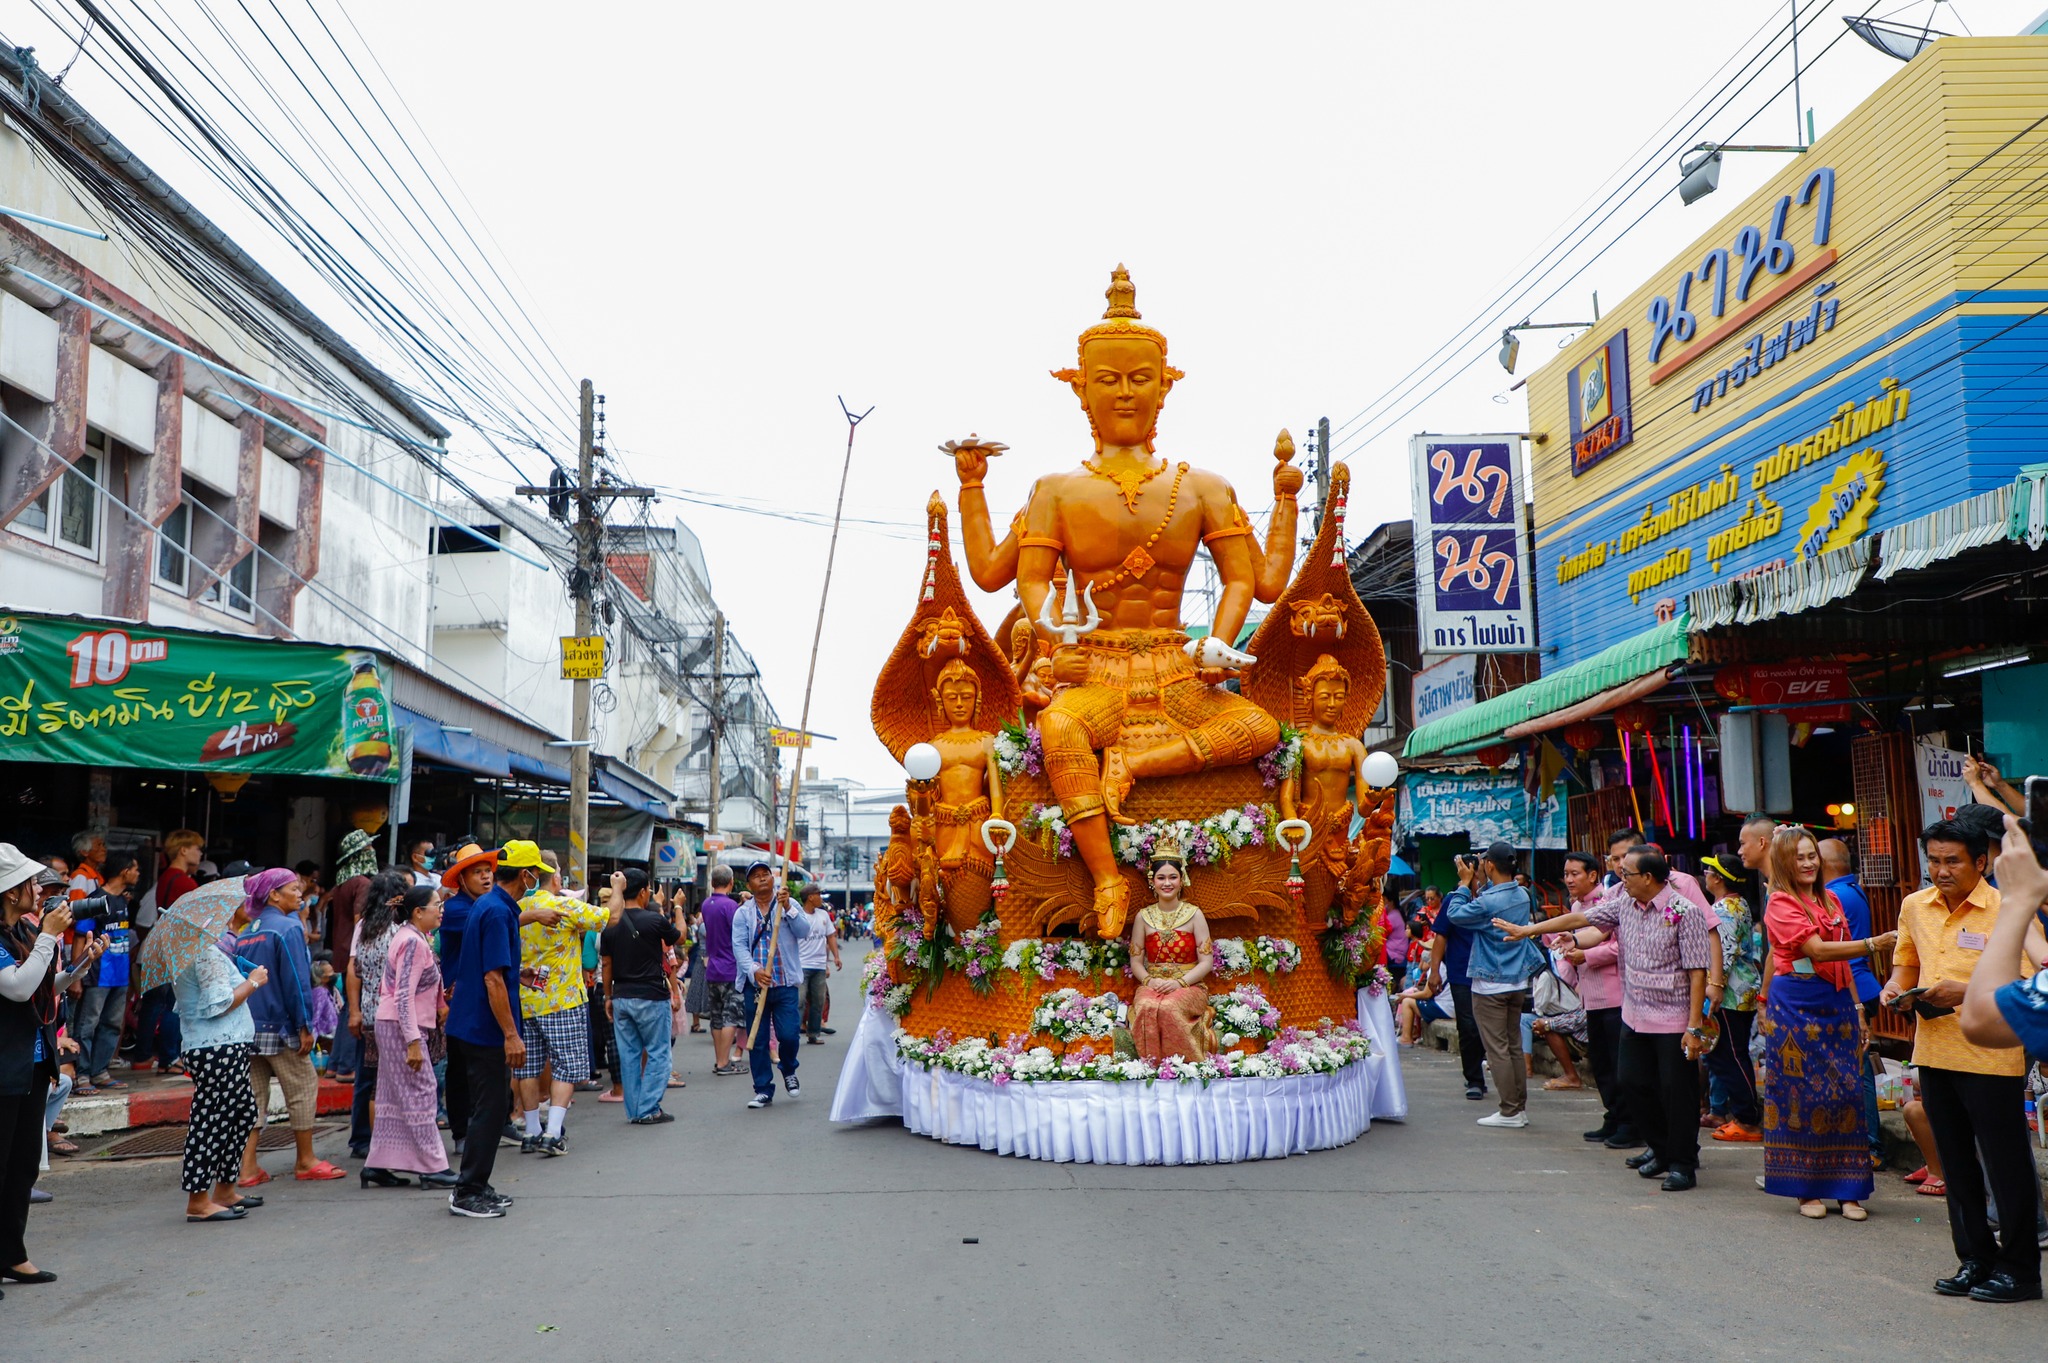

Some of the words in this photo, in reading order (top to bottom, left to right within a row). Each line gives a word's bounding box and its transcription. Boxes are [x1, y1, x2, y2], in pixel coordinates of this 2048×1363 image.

[1647, 166, 1836, 364] นานา
[1691, 281, 1840, 413] การไฟฟ้า
[1431, 448, 1509, 518] นา
[1557, 541, 1607, 585] จำหน่าย
[1619, 463, 1740, 555] เครื่องใช้ไฟฟ้า
[1627, 547, 1692, 605] ทุกชนิด
[1706, 499, 1785, 574] ทุกยี่ห้อ
[1436, 535, 1515, 606] นา
[131, 639, 166, 662] บาท
[1434, 615, 1525, 647] การไฟฟ้า
[0, 679, 34, 736] มี
[38, 687, 175, 734] วิตามิน
[269, 680, 316, 726] สูง
[1787, 680, 1831, 694] EVE
